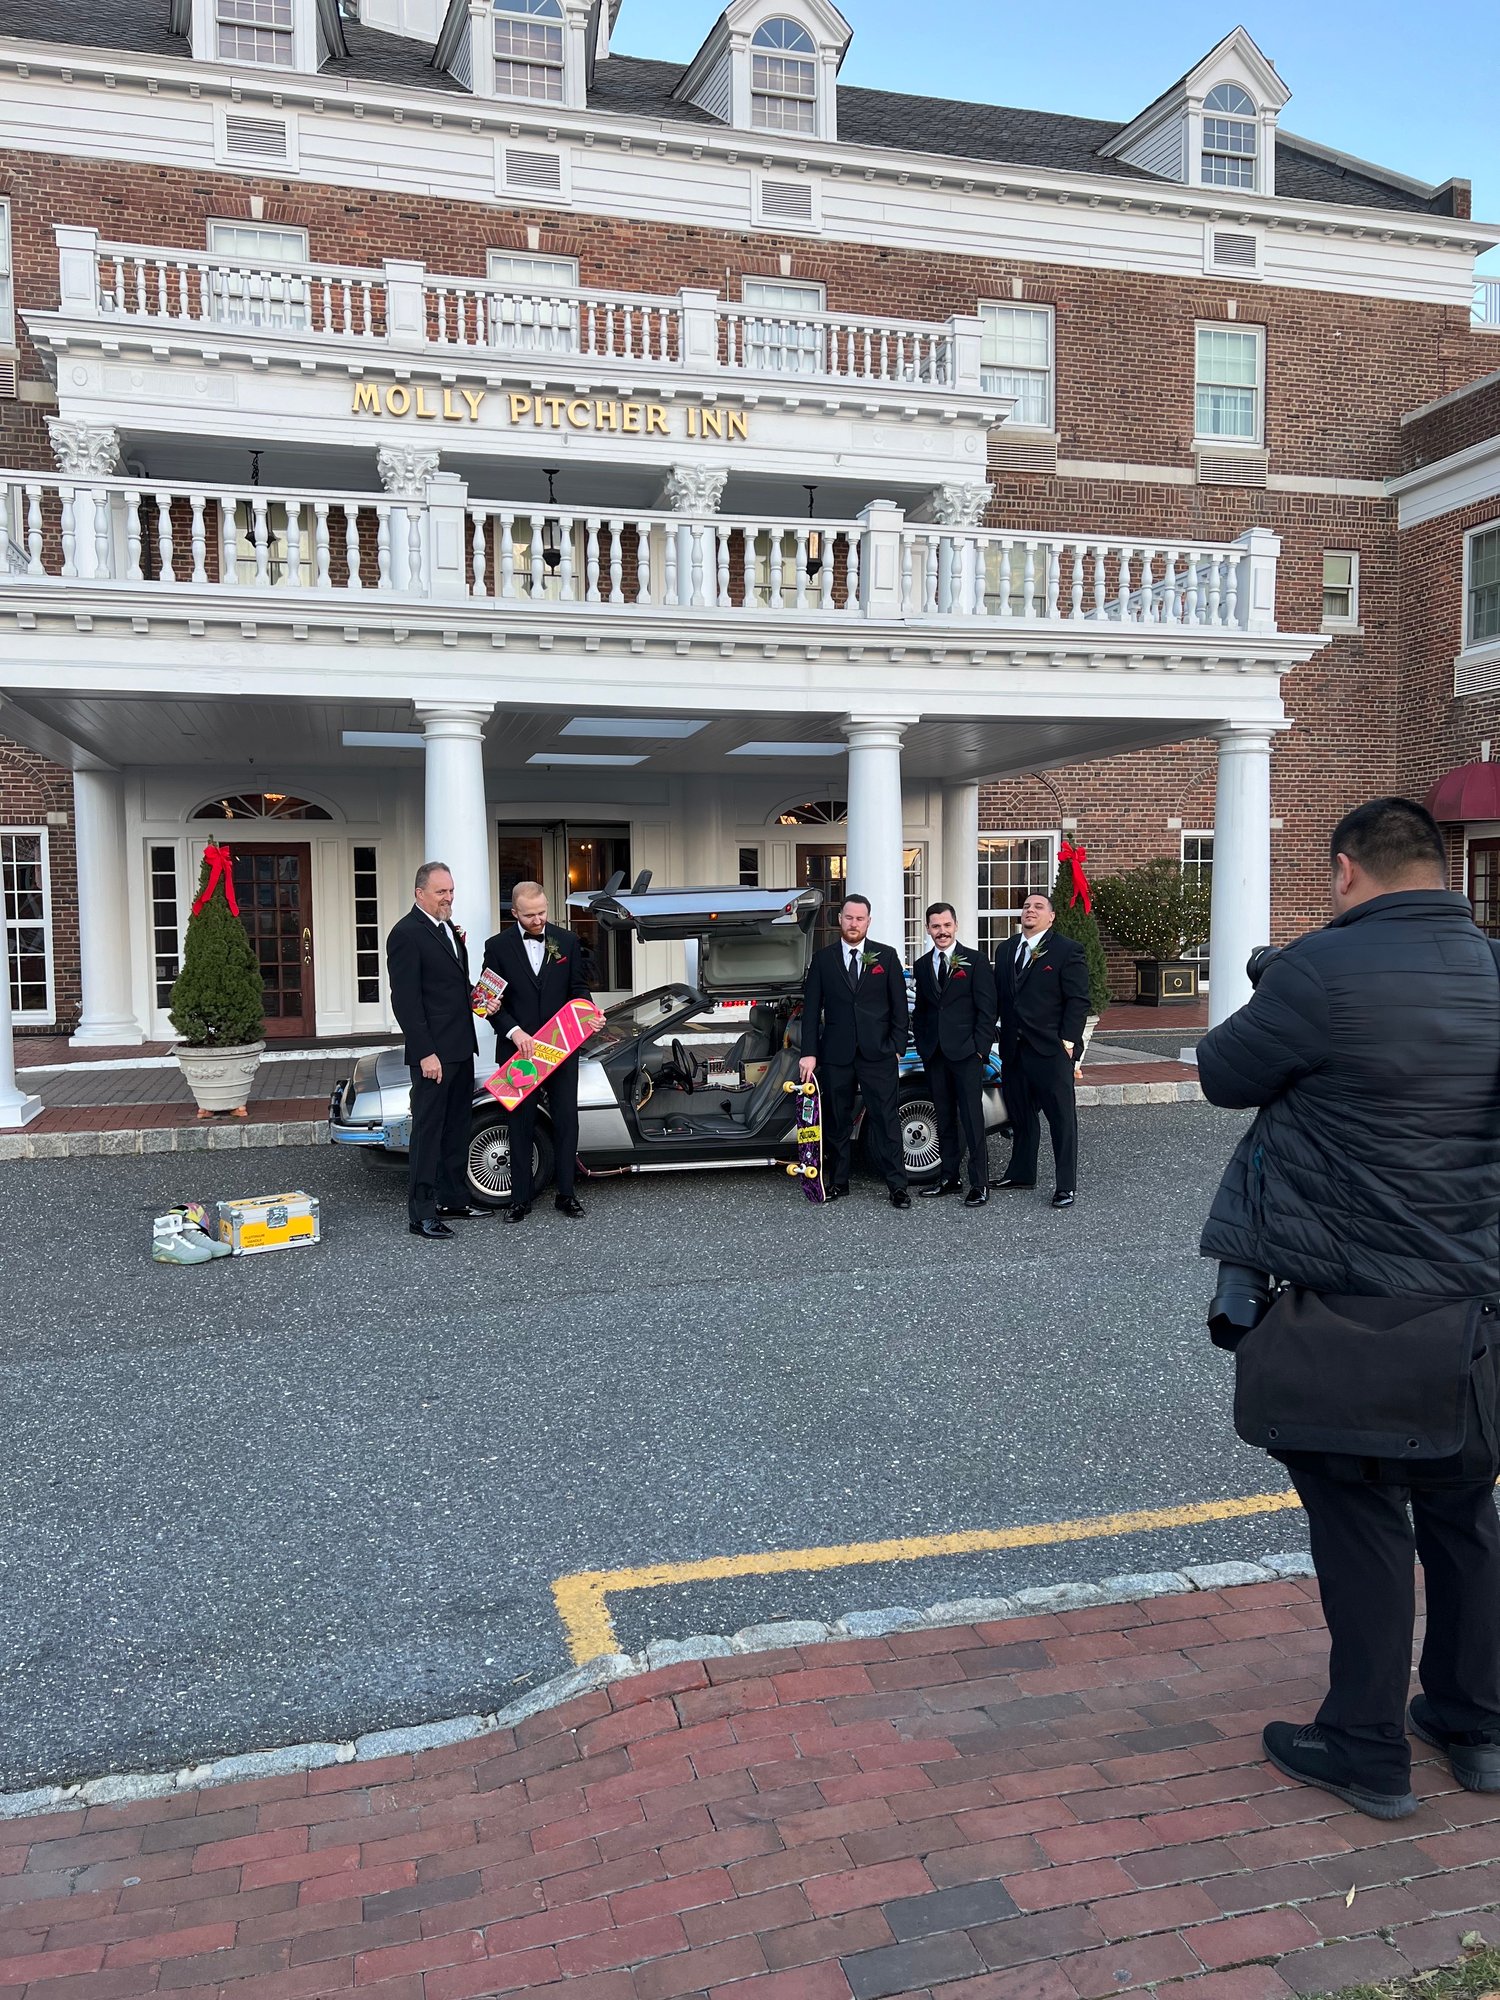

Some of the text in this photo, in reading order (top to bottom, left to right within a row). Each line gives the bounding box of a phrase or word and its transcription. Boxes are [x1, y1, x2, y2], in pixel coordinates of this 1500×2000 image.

[352, 382, 749, 440] MOLLY PITCHER INN
[533, 1050, 557, 1064] OARD
